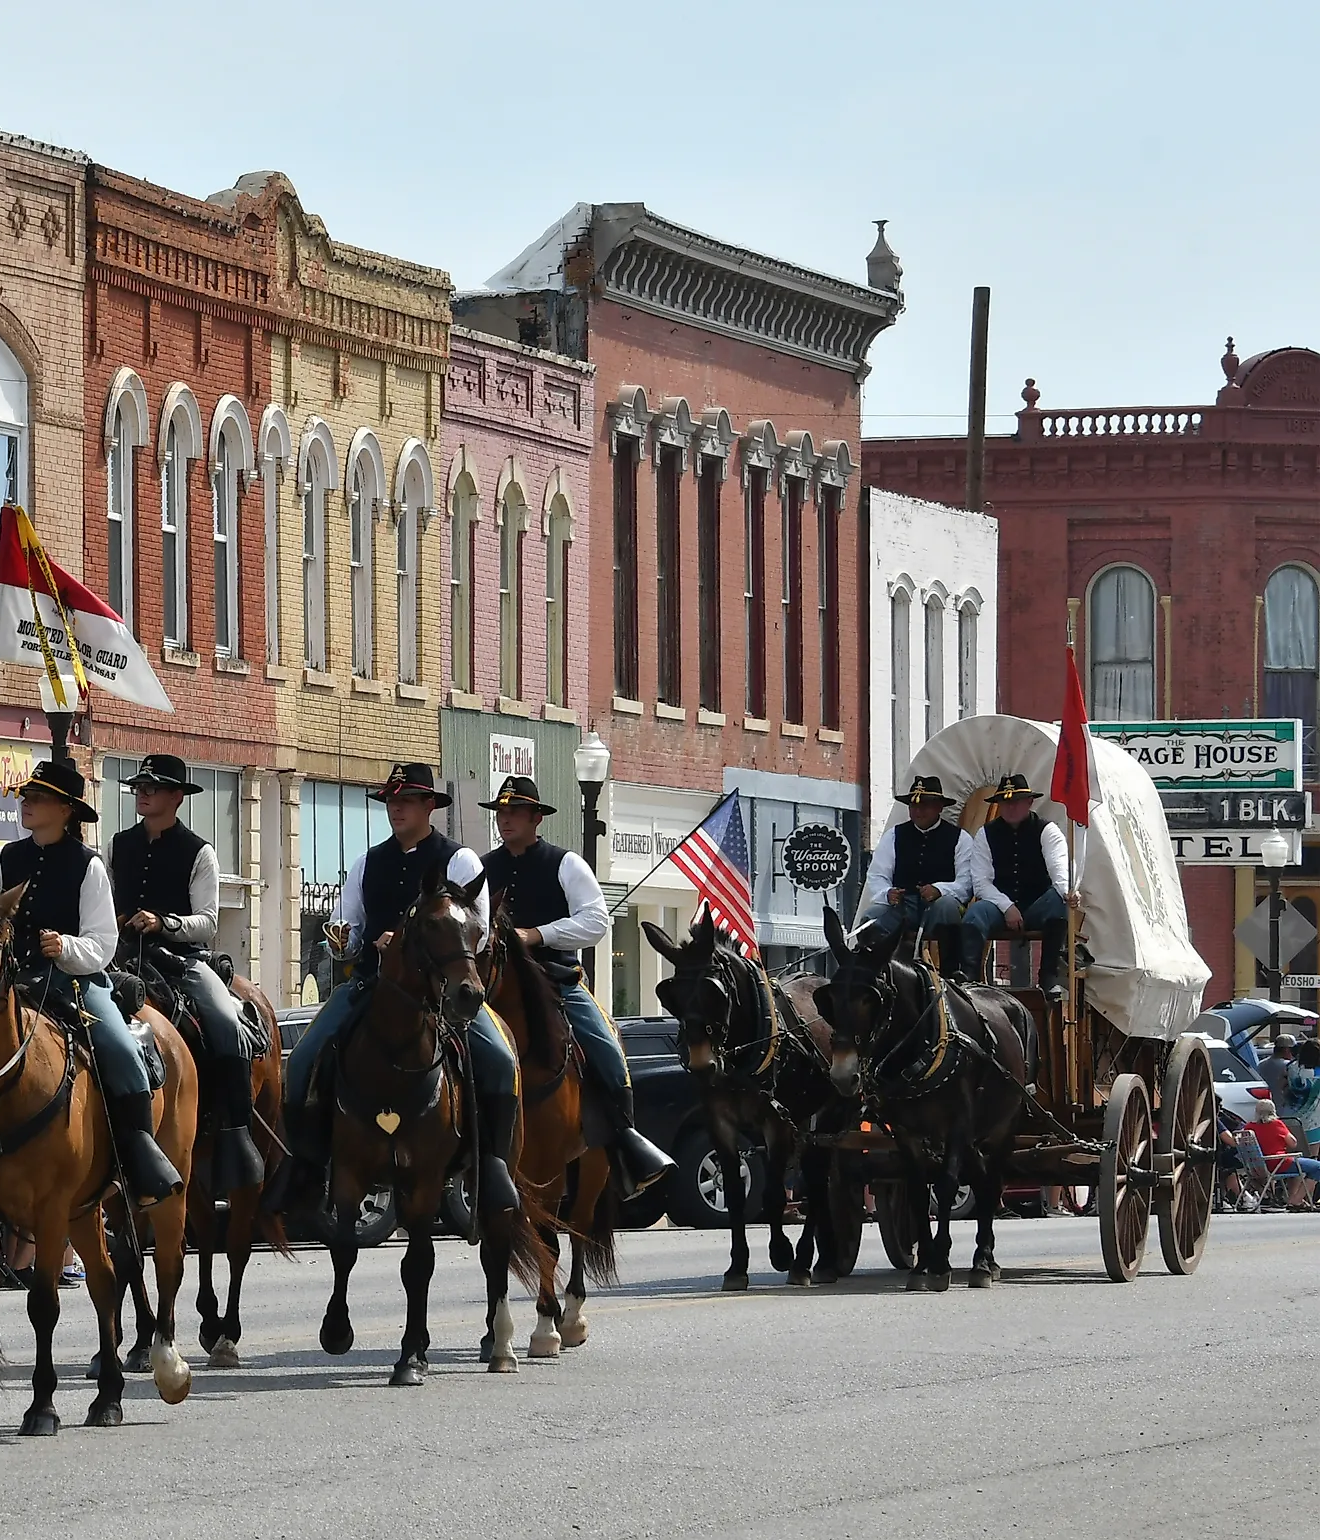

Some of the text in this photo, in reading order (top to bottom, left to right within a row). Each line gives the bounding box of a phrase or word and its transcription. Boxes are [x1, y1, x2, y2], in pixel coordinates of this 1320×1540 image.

[17, 619, 64, 645] MOUTED
[96, 650, 128, 670] GUARD
[50, 648, 73, 663] RILE
[82, 659, 117, 681] KANSAS
[492, 742, 533, 777] Flint Hills
[1123, 744, 1278, 769] TAGE HOUSE
[7, 809, 18, 822] out
[1220, 799, 1298, 821] 1 BLK.
[790, 849, 842, 862] Wooden
[1171, 836, 1263, 858] TEL
[795, 862, 837, 872] SPOON
